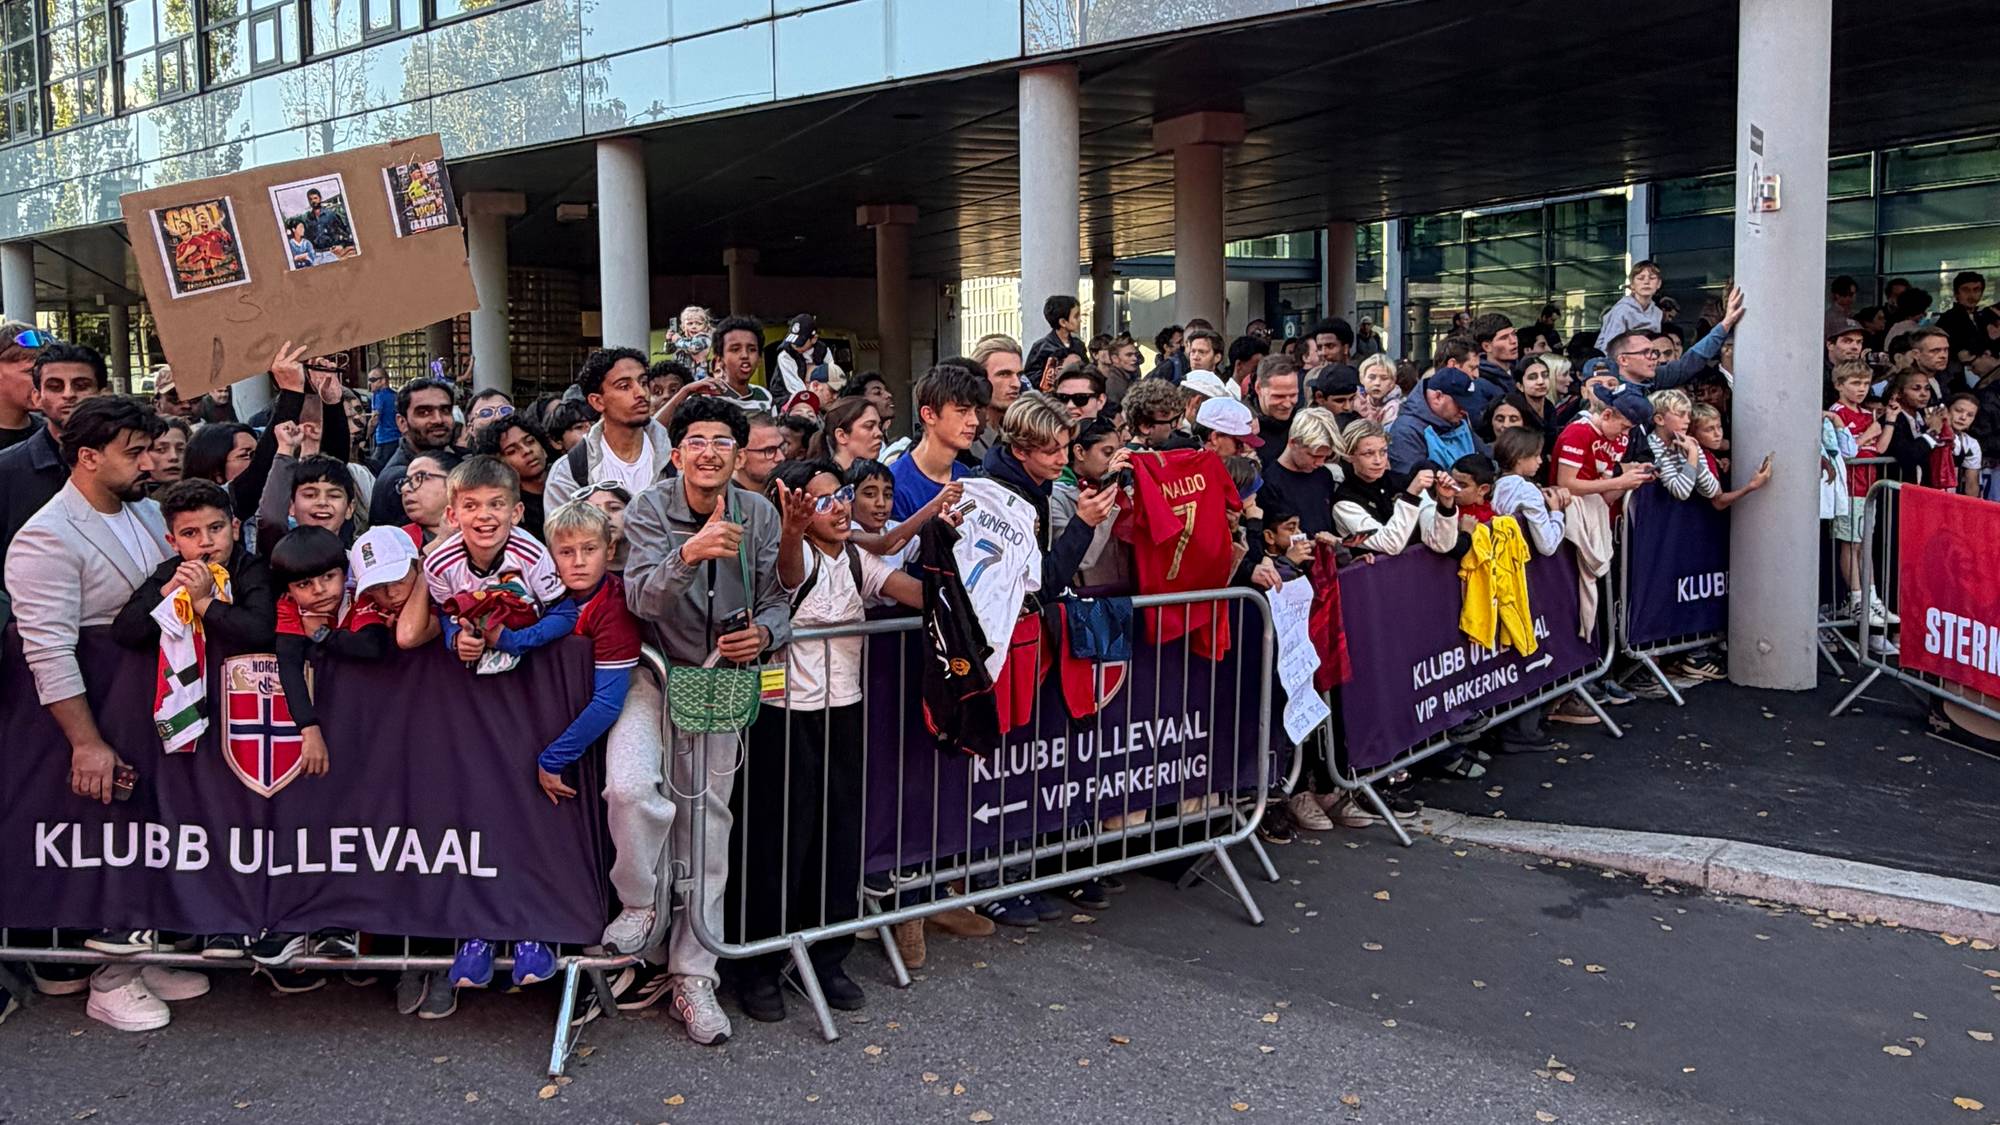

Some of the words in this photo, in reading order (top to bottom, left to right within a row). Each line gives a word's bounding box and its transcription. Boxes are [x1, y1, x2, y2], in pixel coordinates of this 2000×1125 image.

[1161, 474, 1206, 499] NALDO
[977, 510, 1023, 546] RONALDO
[1166, 501, 1197, 580] 7
[965, 538, 1003, 594] 7
[1677, 571, 1728, 603] KLUB
[1413, 646, 1466, 690] KLUBB
[1470, 615, 1551, 666] ULLAL
[1416, 696, 1438, 723] VIP
[1443, 663, 1519, 712] PARKERING
[973, 737, 1066, 783] KLUBB
[1077, 710, 1208, 762] ULLEVAAL
[1041, 781, 1080, 811] VIP
[1086, 754, 1207, 804] PARKERING
[35, 822, 210, 871] KLUBB
[229, 826, 499, 878] ULLEVAAL
